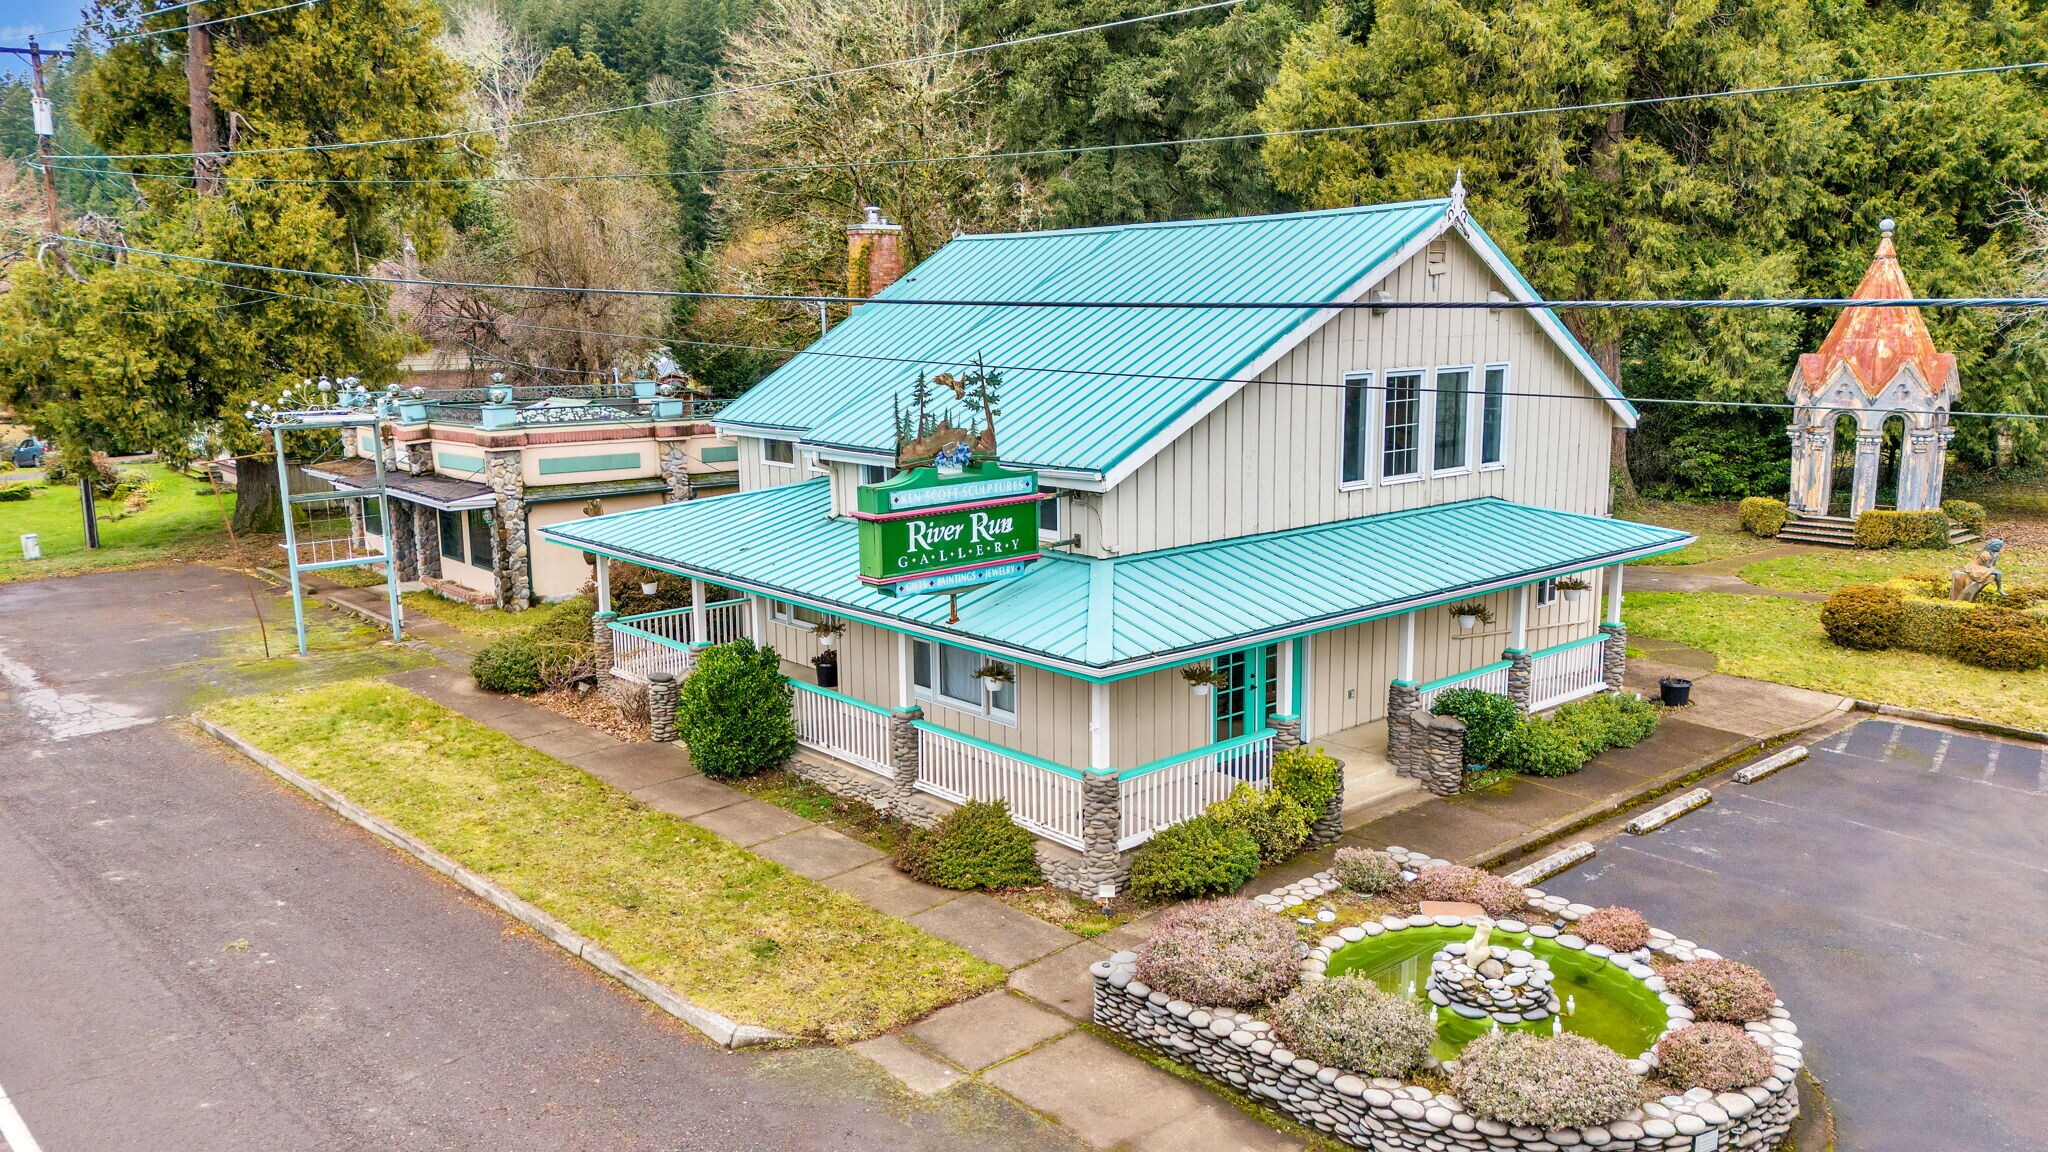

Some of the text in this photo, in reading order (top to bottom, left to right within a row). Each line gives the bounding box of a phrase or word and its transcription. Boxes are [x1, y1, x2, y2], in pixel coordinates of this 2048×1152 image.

[924, 488, 959, 502] SCOTT
[962, 480, 1024, 497] SCULPTURES
[906, 512, 1014, 553] River Run
[937, 571, 976, 587] PAINTINGS
[985, 565, 1016, 580] JEWELRY
